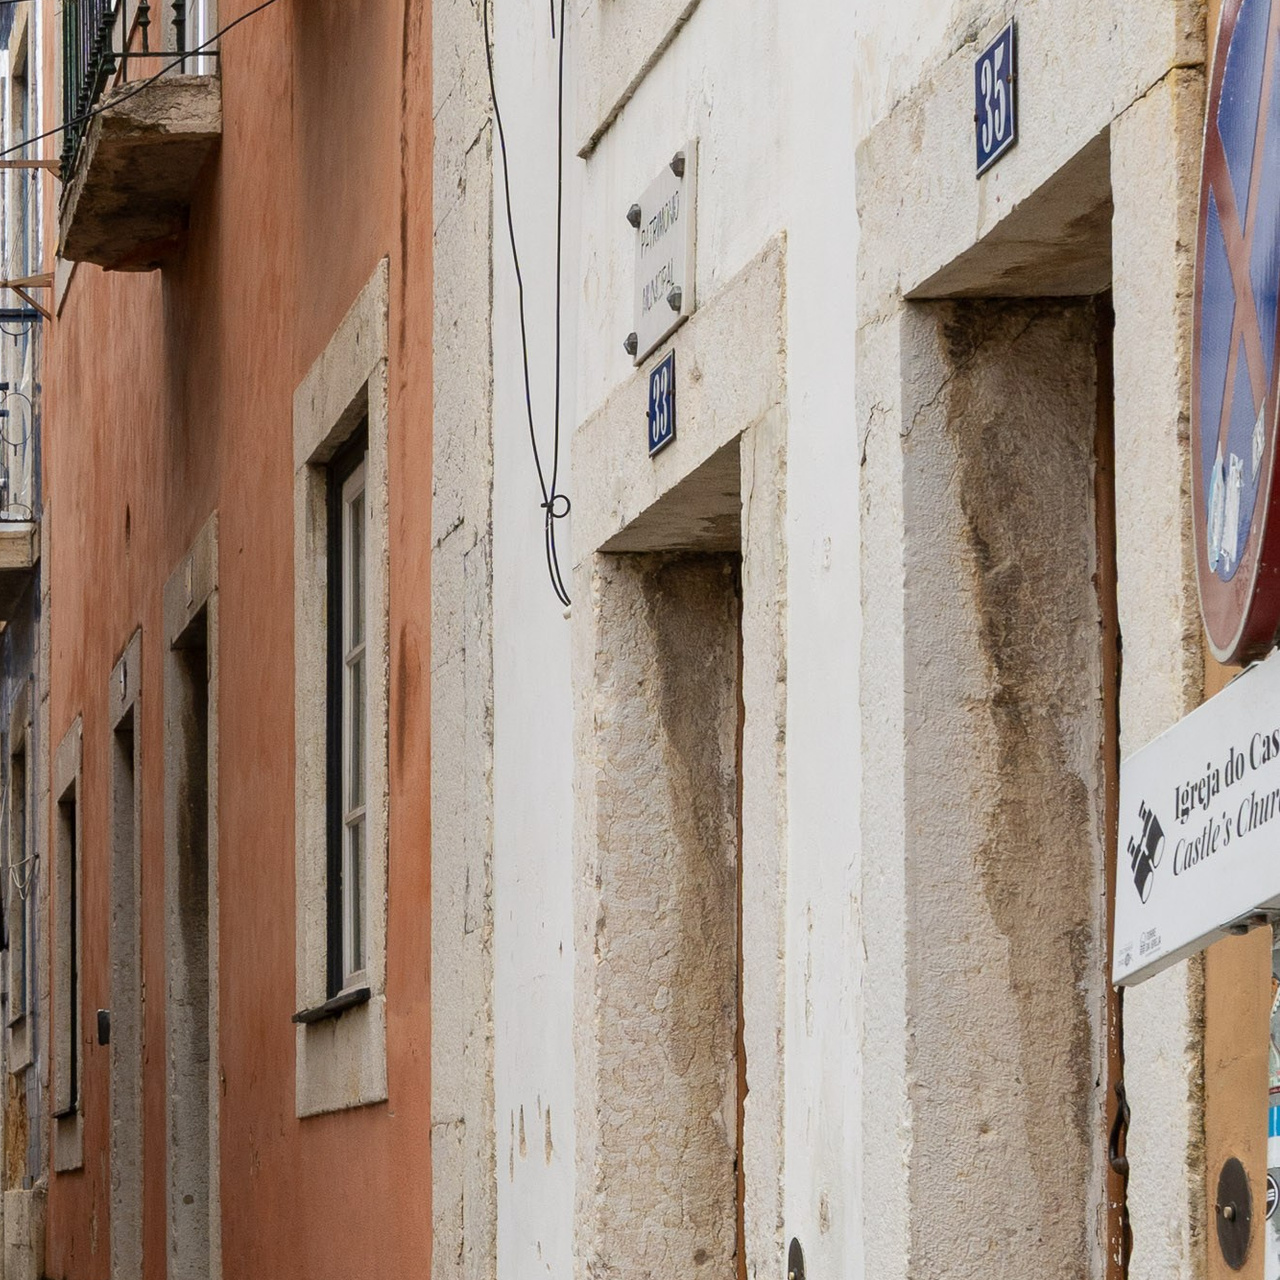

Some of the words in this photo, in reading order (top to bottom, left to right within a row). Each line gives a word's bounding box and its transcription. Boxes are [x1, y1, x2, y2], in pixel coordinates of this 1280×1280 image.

[980, 41, 1006, 154] 35
[652, 366, 668, 443] 33
[1174, 761, 1220, 825] Igreja
[1224, 746, 1245, 788] do
[1172, 811, 1232, 877] Castle's
[1236, 790, 1280, 838] Chur
